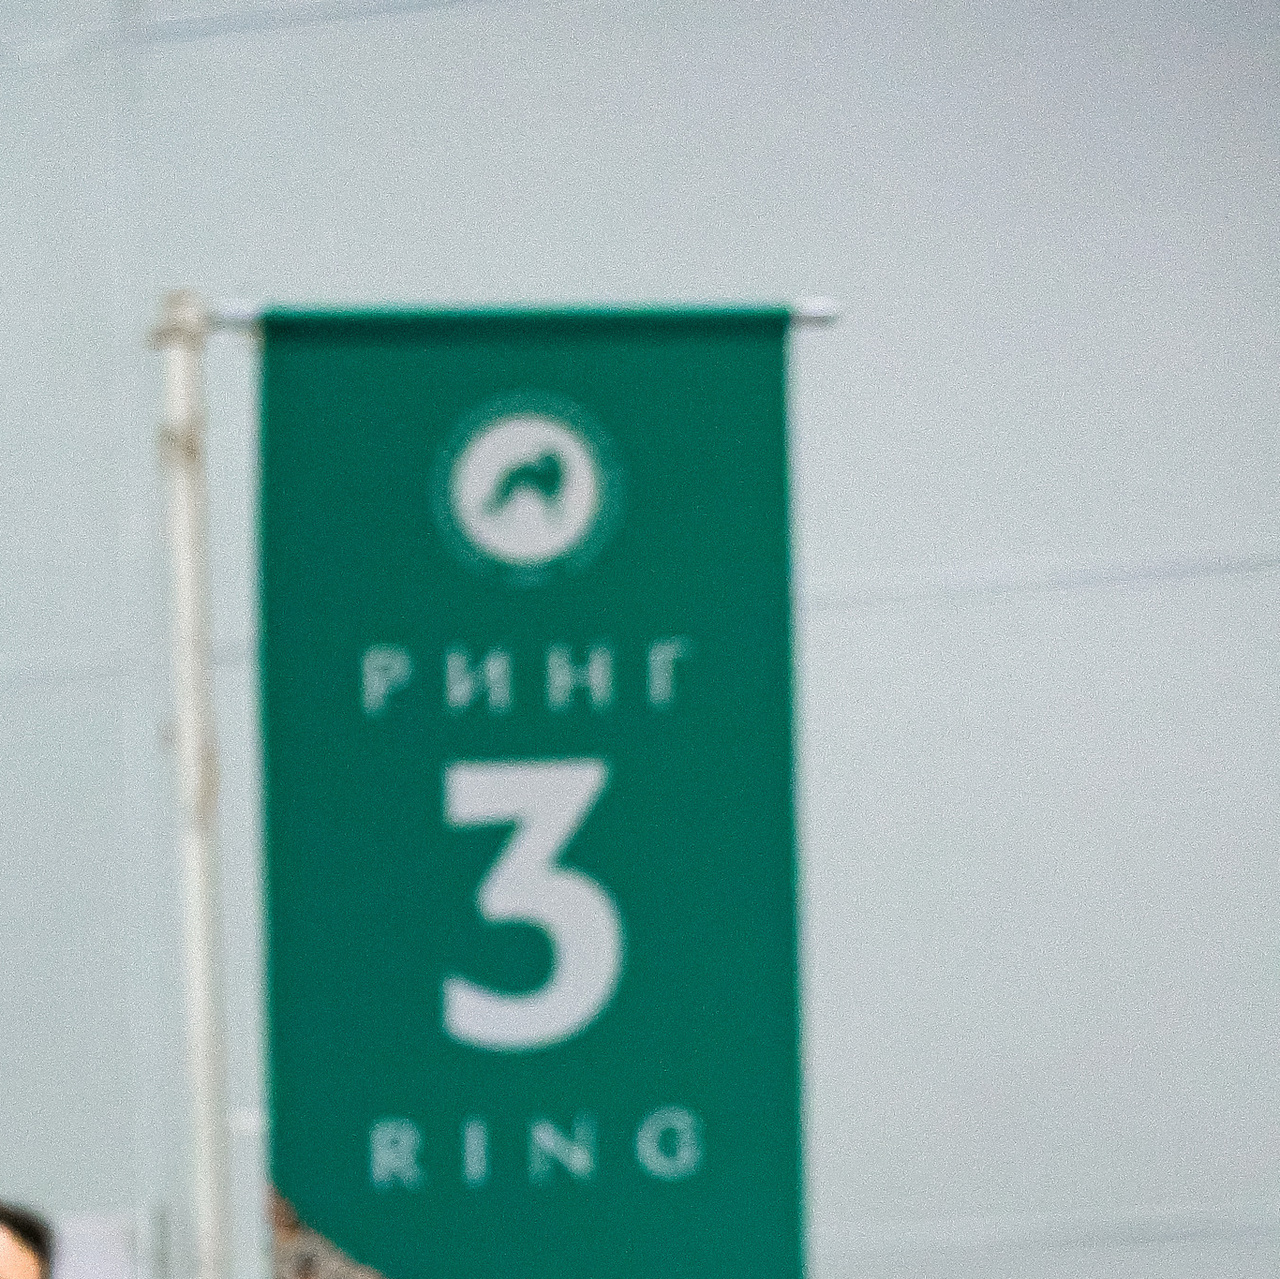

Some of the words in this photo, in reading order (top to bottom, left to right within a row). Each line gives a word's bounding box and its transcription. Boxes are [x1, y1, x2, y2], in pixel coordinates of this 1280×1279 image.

[361, 639, 690, 714] РИНГ
[442, 758, 625, 1052] 3
[367, 1107, 704, 1188] RING
